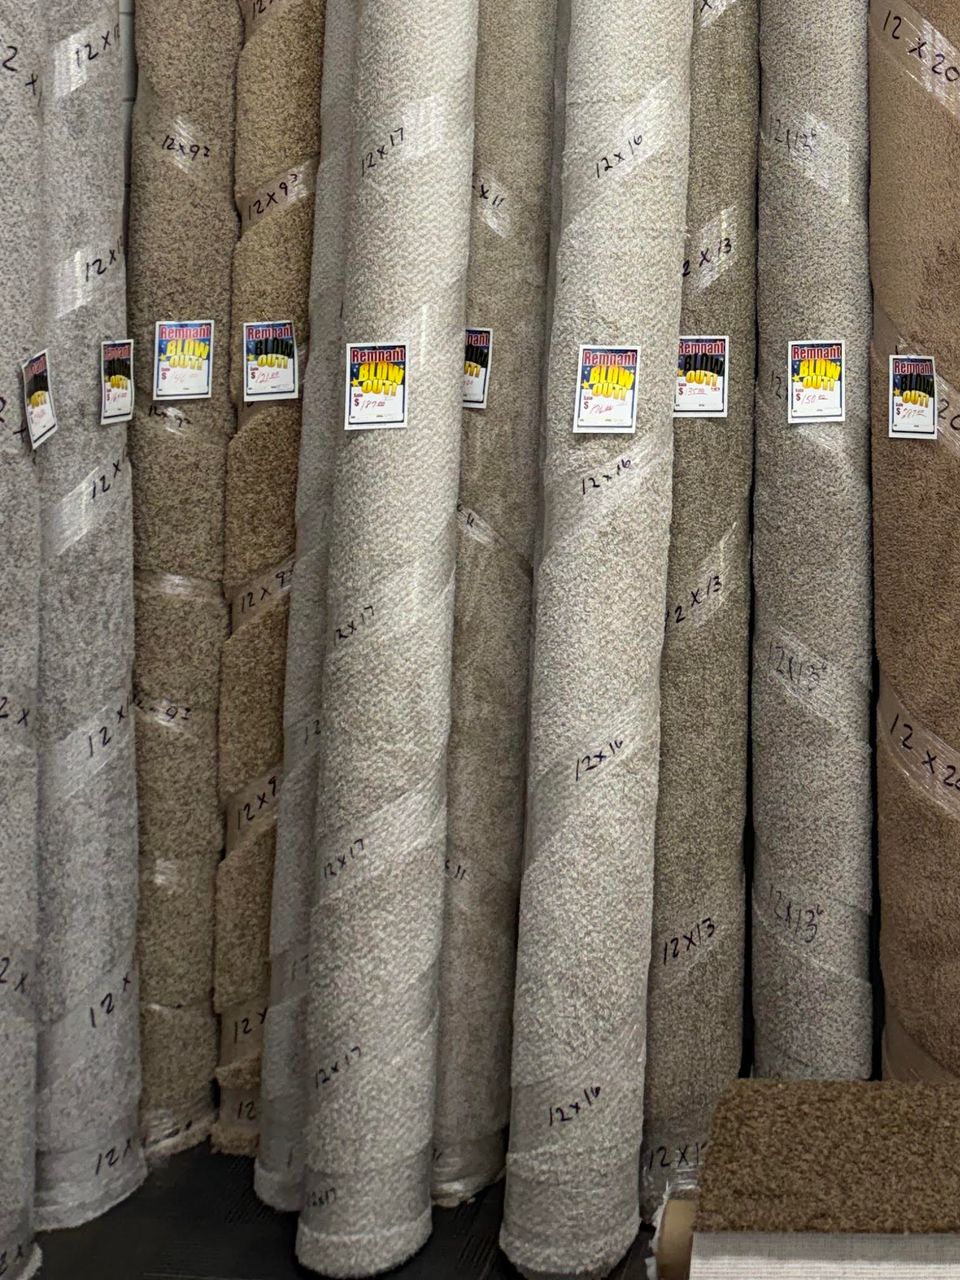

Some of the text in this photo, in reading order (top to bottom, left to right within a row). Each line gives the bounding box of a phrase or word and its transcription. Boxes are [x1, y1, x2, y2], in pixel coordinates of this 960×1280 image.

[160, 326, 209, 339] Remnant
[247, 325, 291, 340] Remnant
[167, 340, 209, 359] BLOW
[352, 348, 405, 363] Remnant
[793, 345, 841, 360] Remnant
[583, 351, 636, 366] Remnant
[358, 361, 404, 384] BLOW
[800, 358, 842, 381] BLOW
[895, 361, 933, 375] Remnant
[590, 365, 635, 389] BLOW
